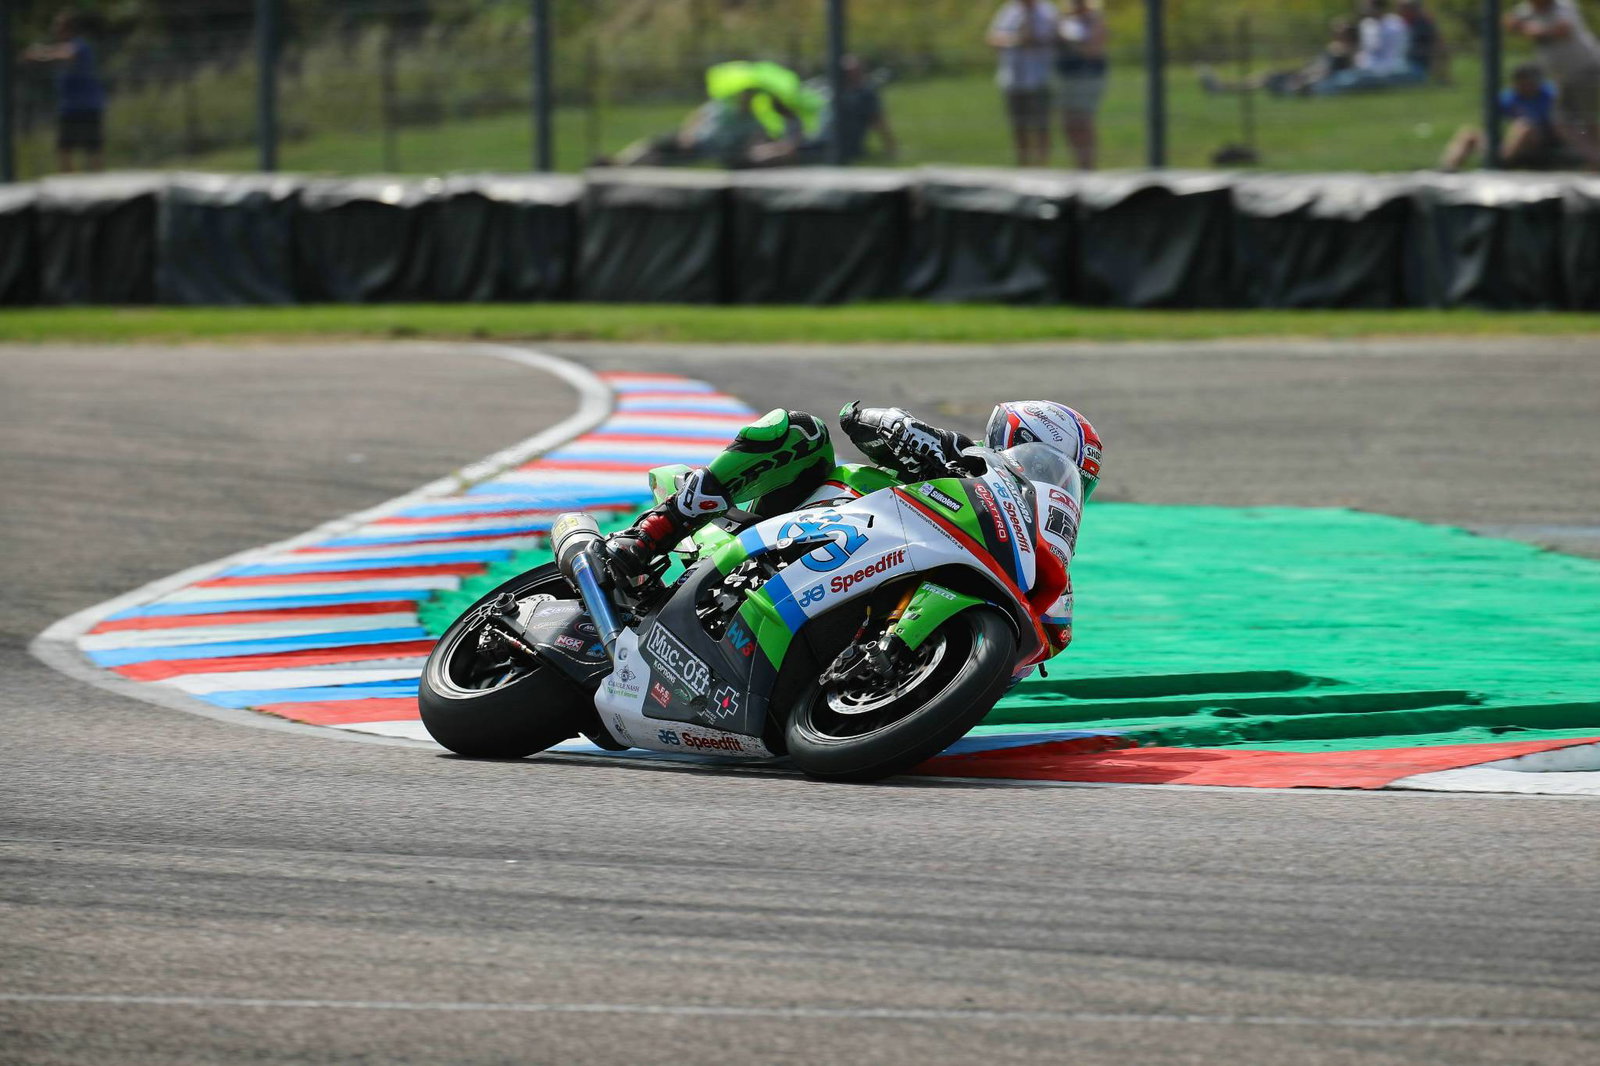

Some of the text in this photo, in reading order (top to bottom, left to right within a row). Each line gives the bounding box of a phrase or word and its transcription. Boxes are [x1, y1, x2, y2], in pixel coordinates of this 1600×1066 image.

[930, 490, 960, 511] Silkolene
[975, 484, 1006, 539] QUATTRO
[1003, 501, 1030, 553] Speedfit
[830, 550, 905, 593] Speedfit
[556, 635, 582, 648] NGK
[651, 627, 709, 695] Muc-Off
[682, 732, 744, 751] Speedfit
